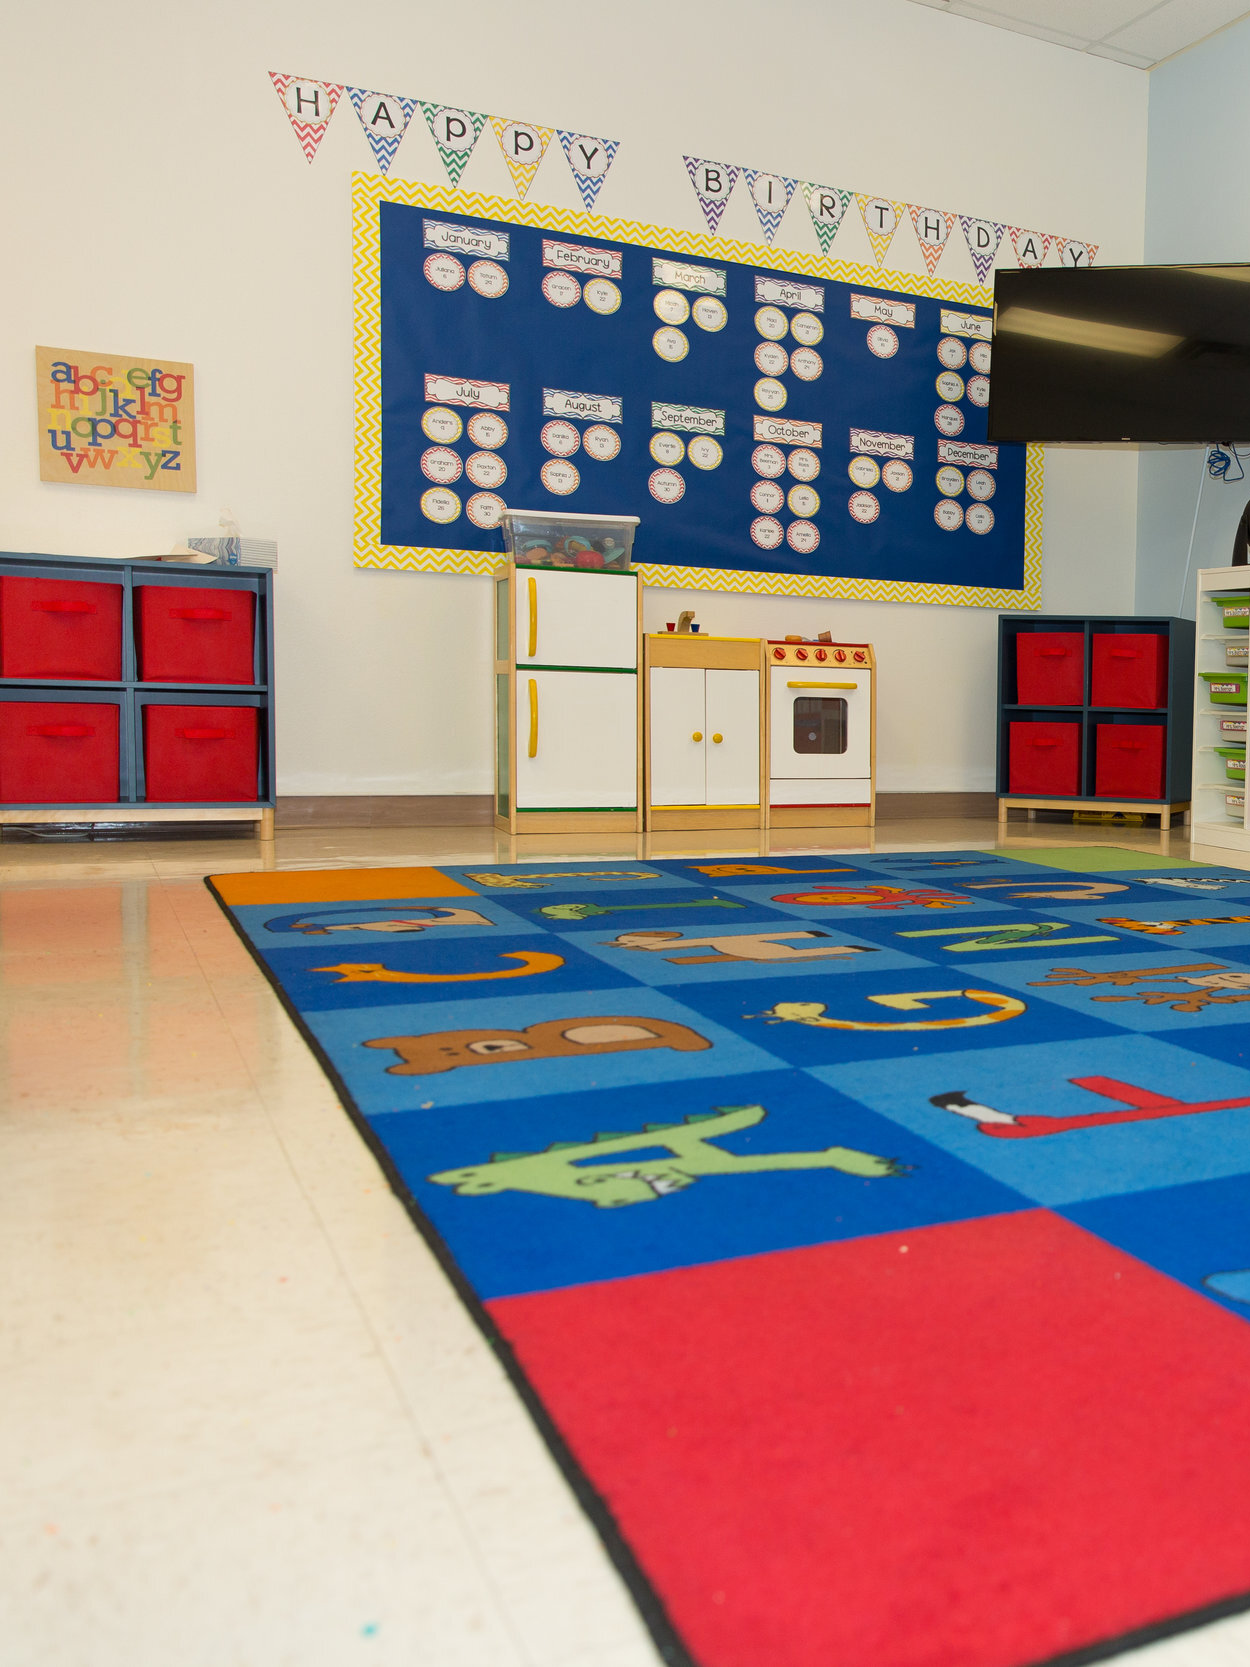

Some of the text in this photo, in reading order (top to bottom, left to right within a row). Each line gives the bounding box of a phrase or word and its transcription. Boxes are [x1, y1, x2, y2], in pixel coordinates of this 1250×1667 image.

[442, 232, 492, 250] January
[556, 250, 610, 269] February
[674, 271, 706, 285] March
[780, 288, 802, 303] April
[874, 305, 894, 318] May
[960, 320, 982, 332] June
[456, 387, 481, 400] July
[564, 400, 602, 414] August
[661, 410, 717, 427] September
[768, 425, 810, 438] October
[860, 438, 906, 451] November
[948, 448, 990, 461] December
